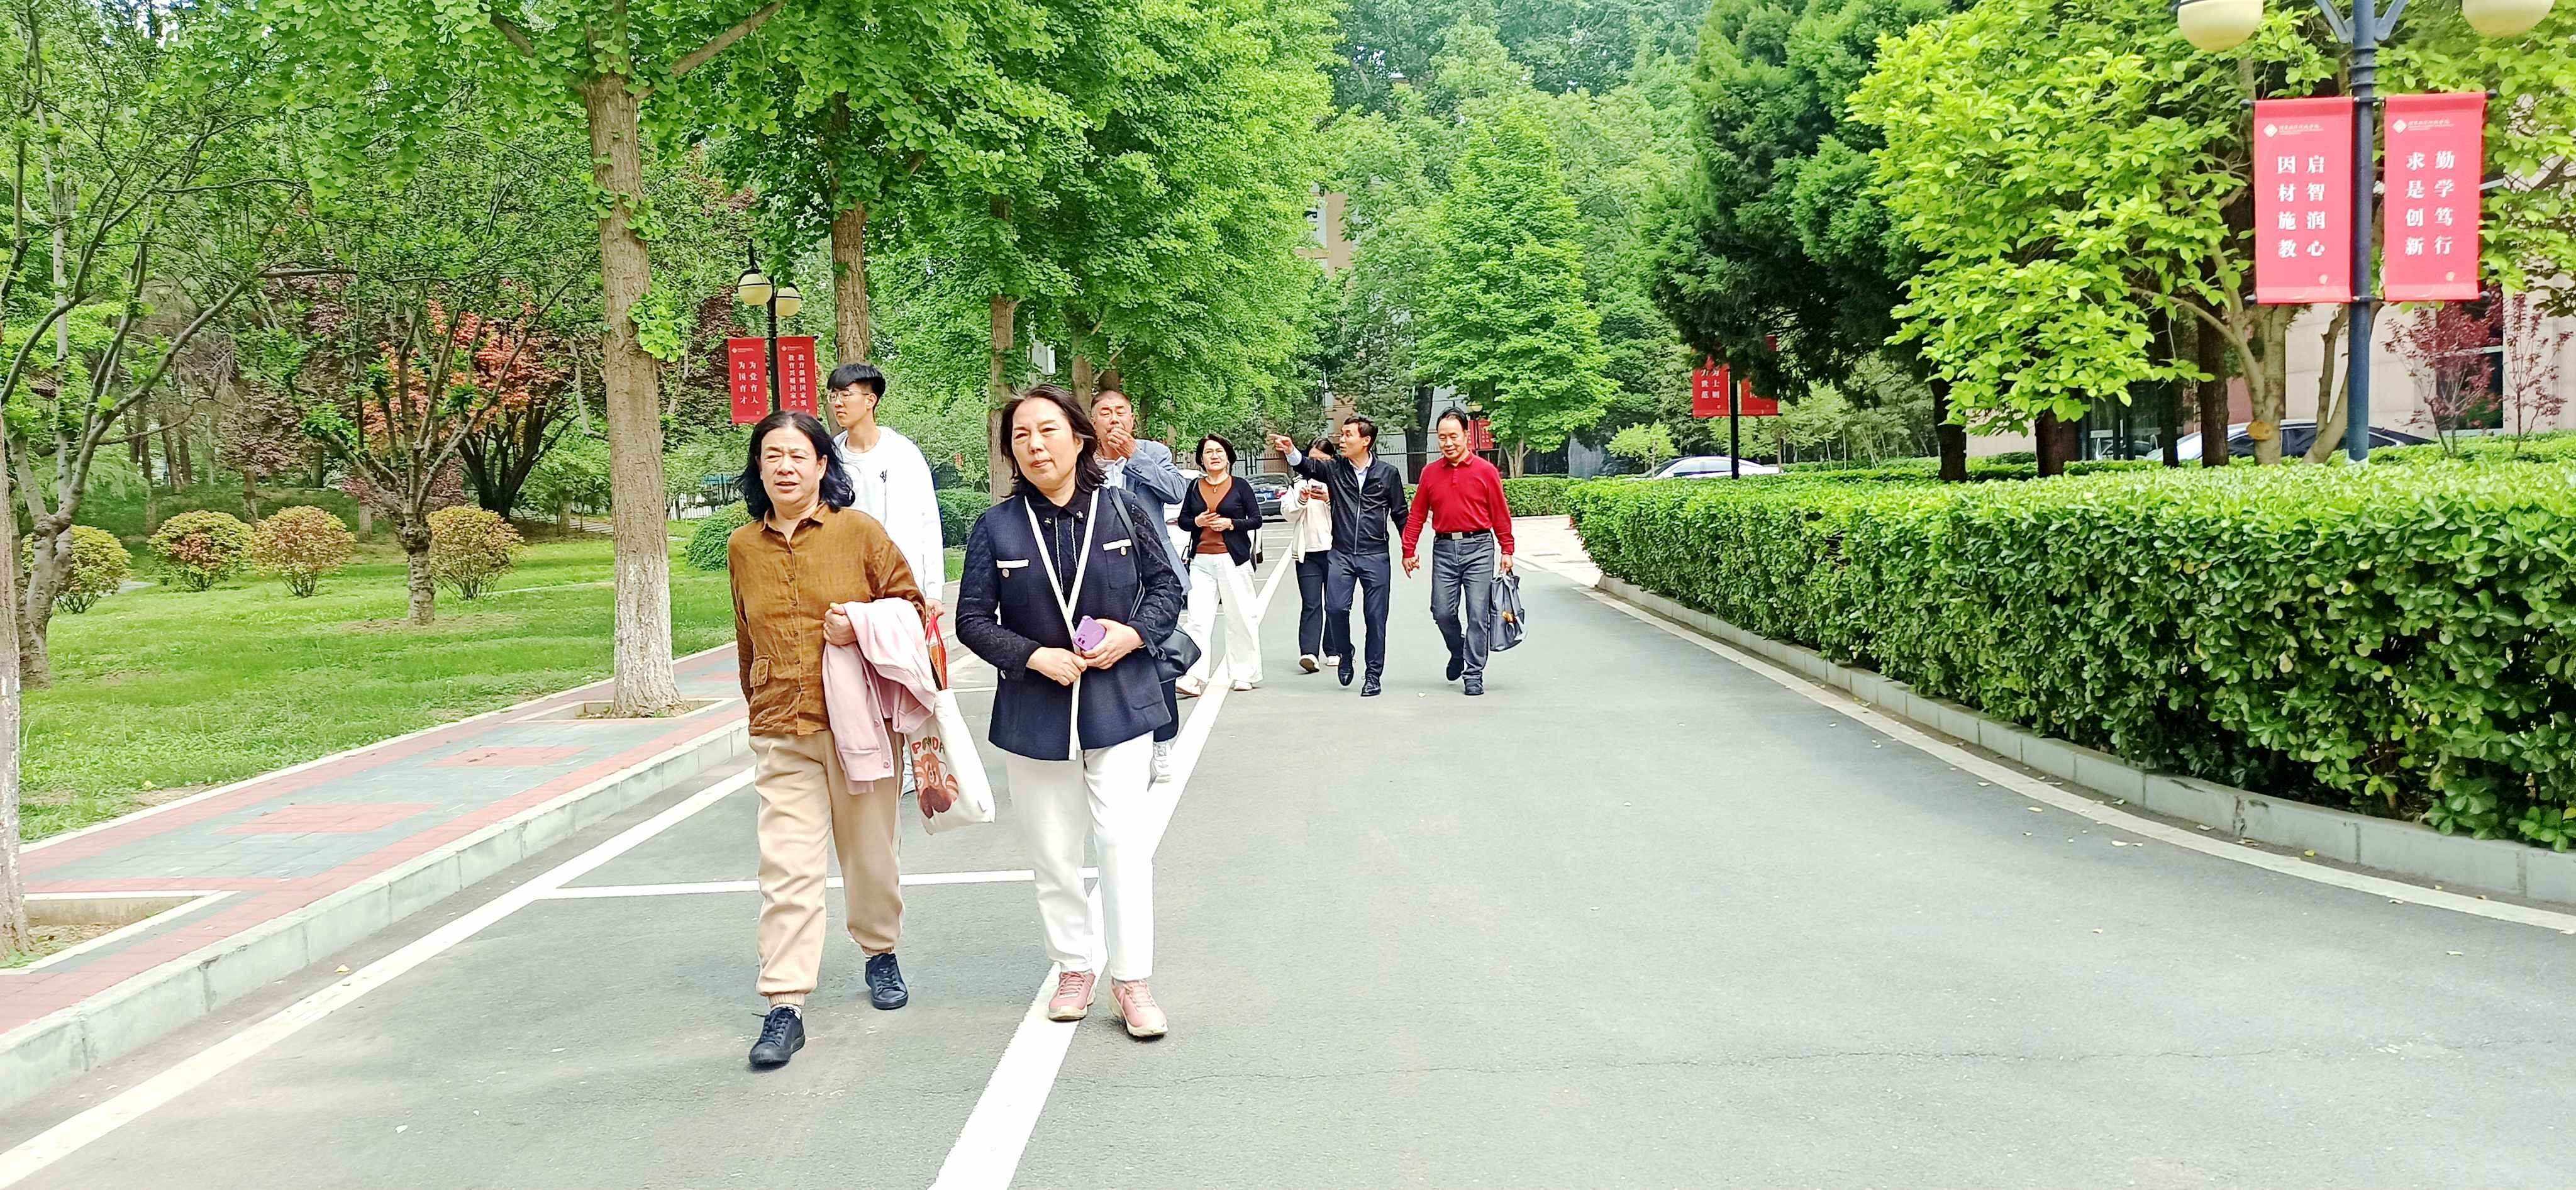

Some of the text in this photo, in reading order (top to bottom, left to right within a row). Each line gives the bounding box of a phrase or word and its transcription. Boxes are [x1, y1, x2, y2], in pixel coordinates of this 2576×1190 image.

[2277, 155, 2297, 259] 因材施教
[2306, 155, 2326, 257] 启智润心
[2405, 152, 2426, 256] 求是创新
[2434, 150, 2455, 255] 勤学笃行
[738, 361, 748, 404] 为国育才
[749, 361, 759, 404] 为党育人
[789, 354, 797, 407] 教育兴则国家兴
[798, 354, 808, 407] 教育强则国家强
